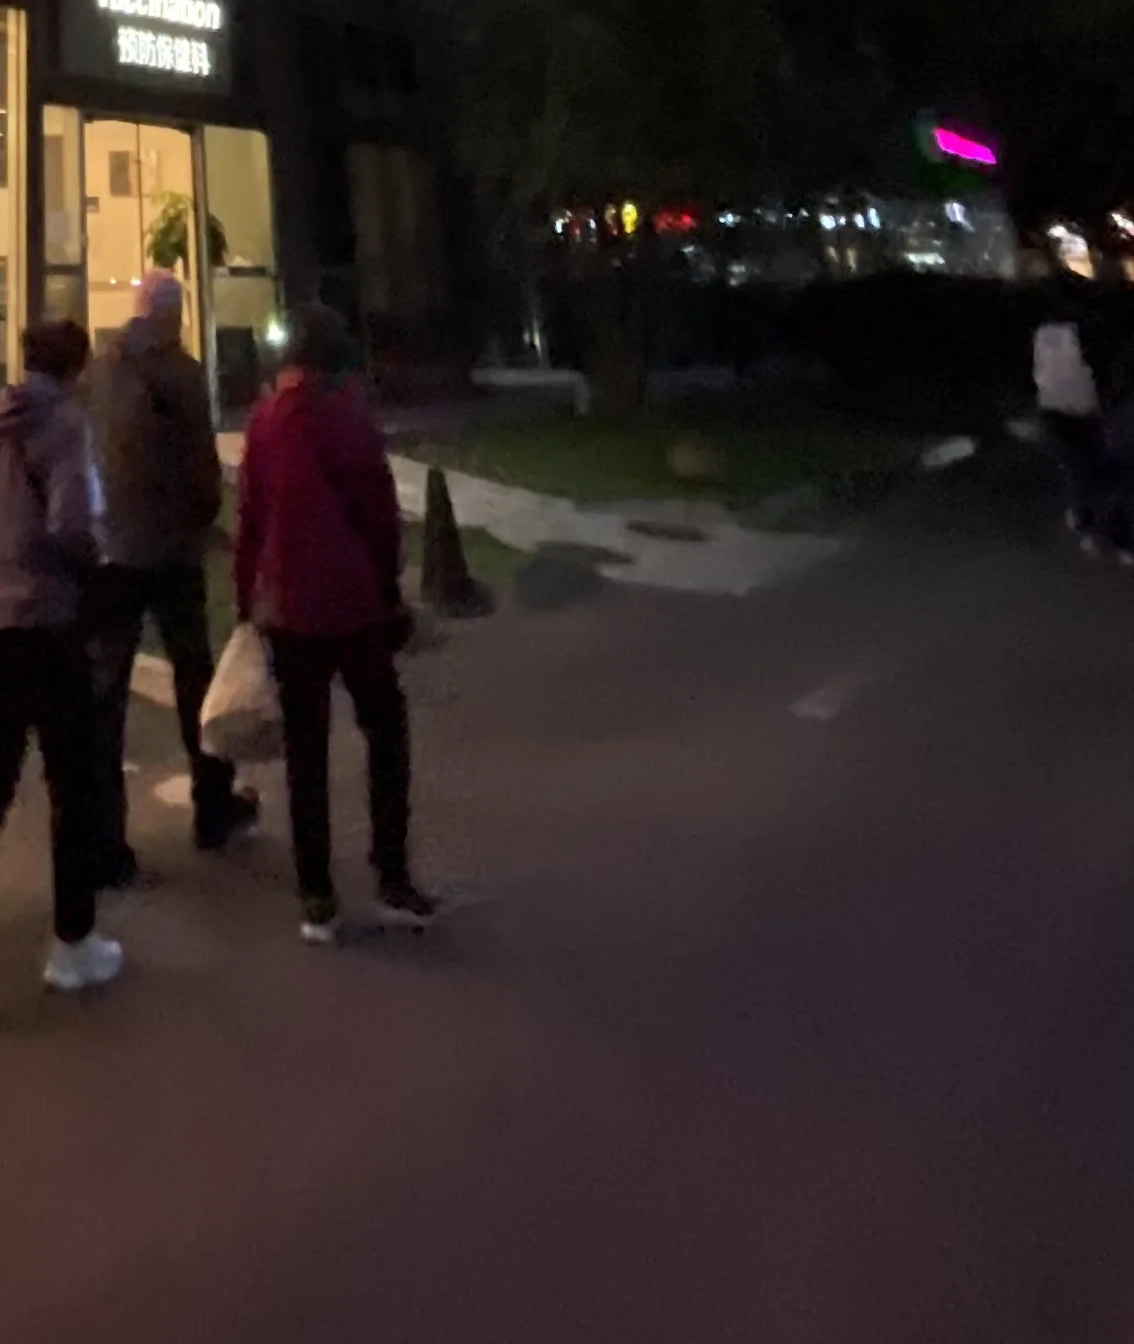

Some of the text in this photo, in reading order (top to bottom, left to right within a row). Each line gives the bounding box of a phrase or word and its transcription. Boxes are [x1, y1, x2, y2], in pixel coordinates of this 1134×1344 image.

[116, 26, 212, 78] 预防保健科
